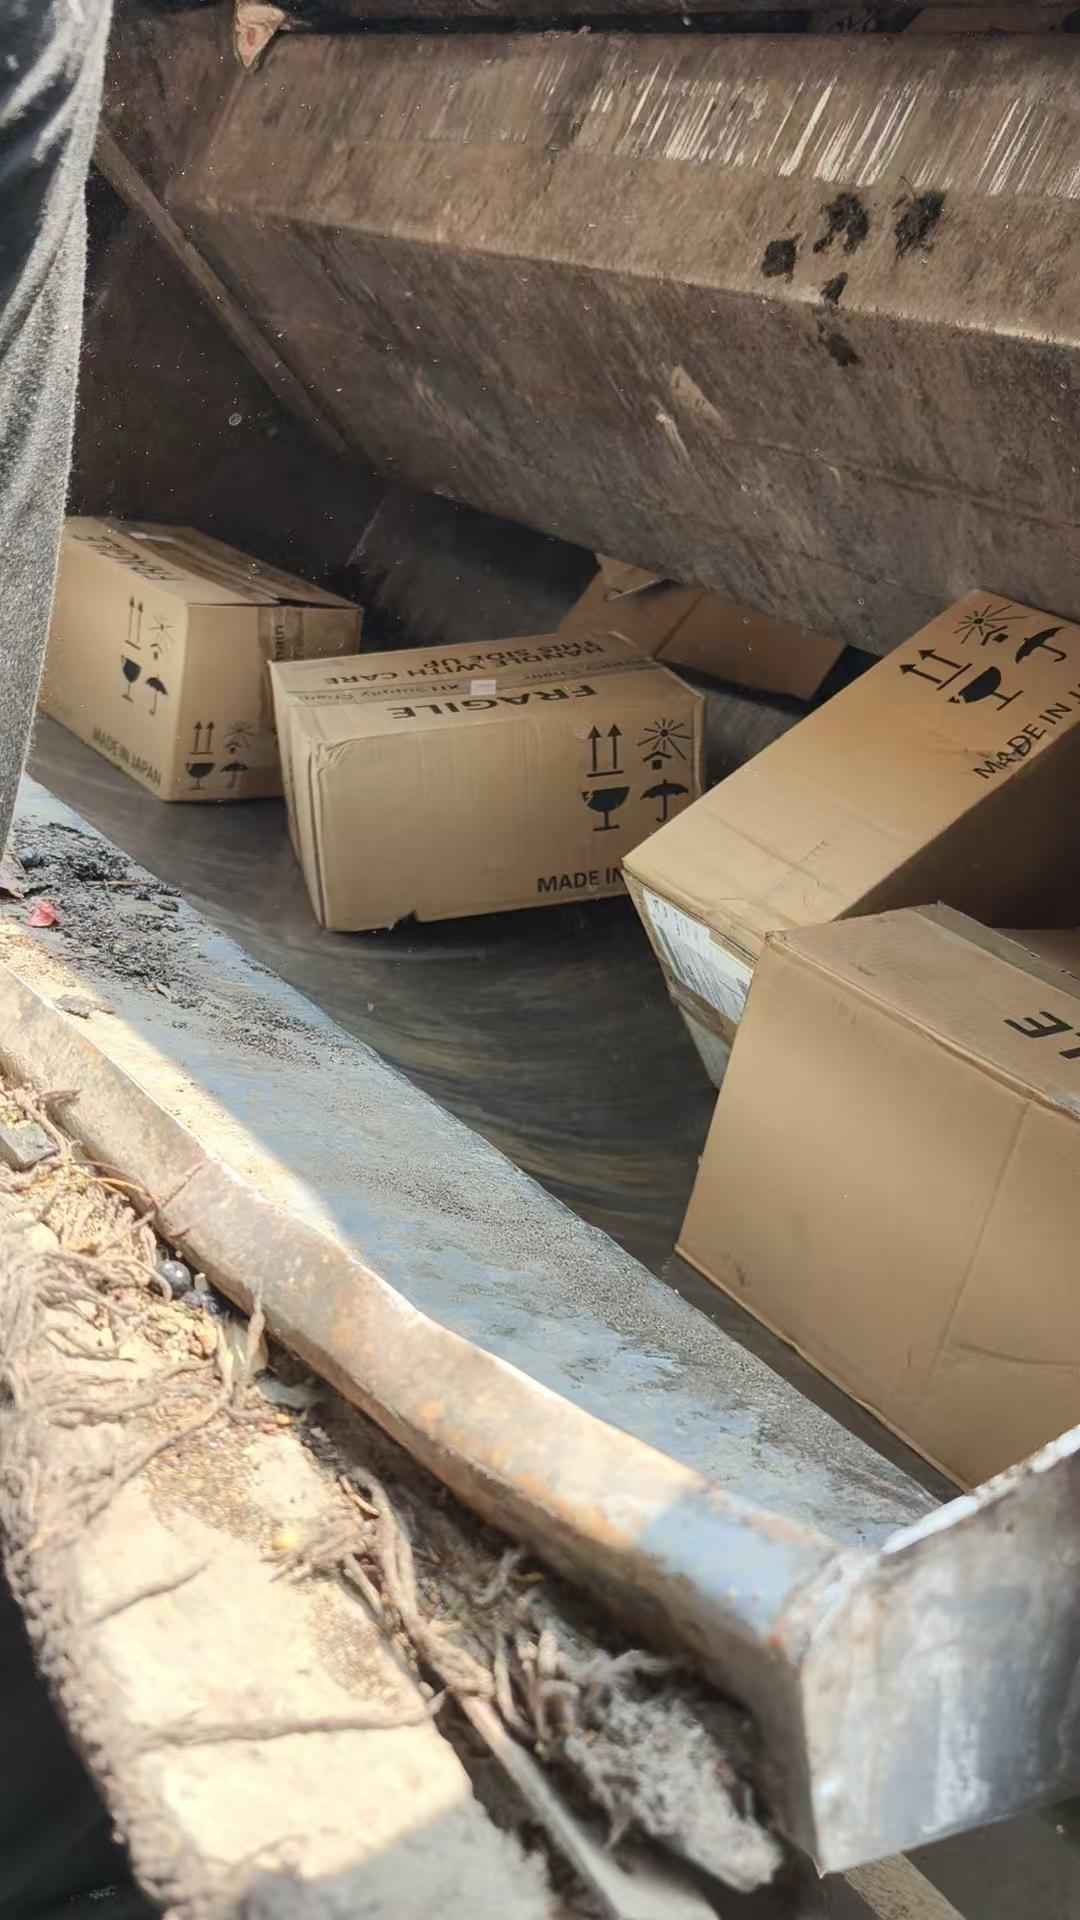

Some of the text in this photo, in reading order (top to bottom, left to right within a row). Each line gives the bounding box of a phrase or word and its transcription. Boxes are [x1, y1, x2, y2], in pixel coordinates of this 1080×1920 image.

[323, 644, 606, 686] HANDLE WITH CARE
[423, 639, 600, 669] THIS SIDE UP
[386, 684, 597, 720] FRAGILE
[972, 702, 1073, 779] MADE IN
[130, 754, 162, 787] JAPAN
[536, 869, 600, 893] MADE
